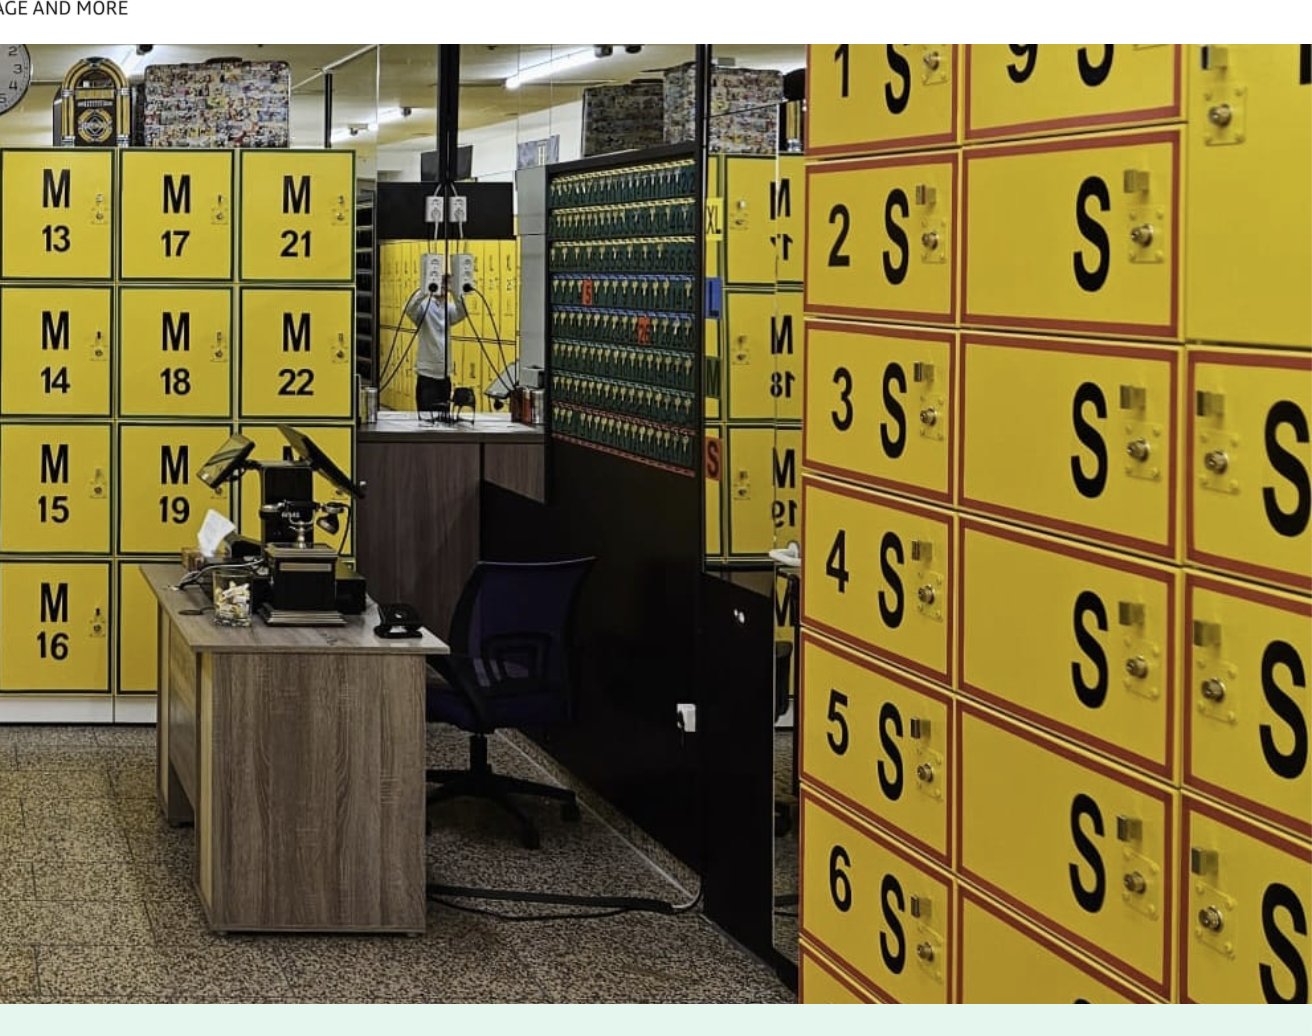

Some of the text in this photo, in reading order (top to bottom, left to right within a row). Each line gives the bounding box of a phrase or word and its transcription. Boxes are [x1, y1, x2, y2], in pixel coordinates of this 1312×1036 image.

[8, 46, 18, 56] 2
[13, 63, 22, 75] 3
[9, 80, 18, 91] 4
[835, 45, 910, 114] 1 S
[43, 169, 70, 208] M
[164, 175, 190, 213] M
[283, 176, 310, 214] M
[43, 225, 70, 252] 13
[162, 231, 189, 256] 17
[281, 230, 310, 257] 21
[829, 204, 849, 266] 2
[883, 189, 909, 284] S
[1074, 176, 1110, 292] S
[708, 281, 720, 317] L
[42, 311, 69, 349] M
[163, 312, 189, 351] M
[283, 313, 310, 351] M
[41, 367, 70, 393] 14
[161, 368, 190, 395] 18
[279, 369, 314, 395] 22
[832, 363, 906, 458] 3 S
[707, 439, 720, 478] S
[1071, 382, 1107, 498] S
[41, 444, 68, 483] M
[162, 446, 188, 484] M
[1263, 401, 1311, 537] S
[39, 496, 69, 523] 15
[160, 496, 189, 524] 19
[826, 530, 849, 593] 4
[879, 532, 904, 628] S
[41, 583, 67, 622] M
[37, 632, 68, 660] 16
[1072, 591, 1108, 708] S
[1260, 641, 1308, 779] S
[827, 690, 903, 800] 5 S
[1070, 794, 1105, 913] S
[830, 846, 905, 974] 6 S
[1259, 883, 1308, 1003] S
